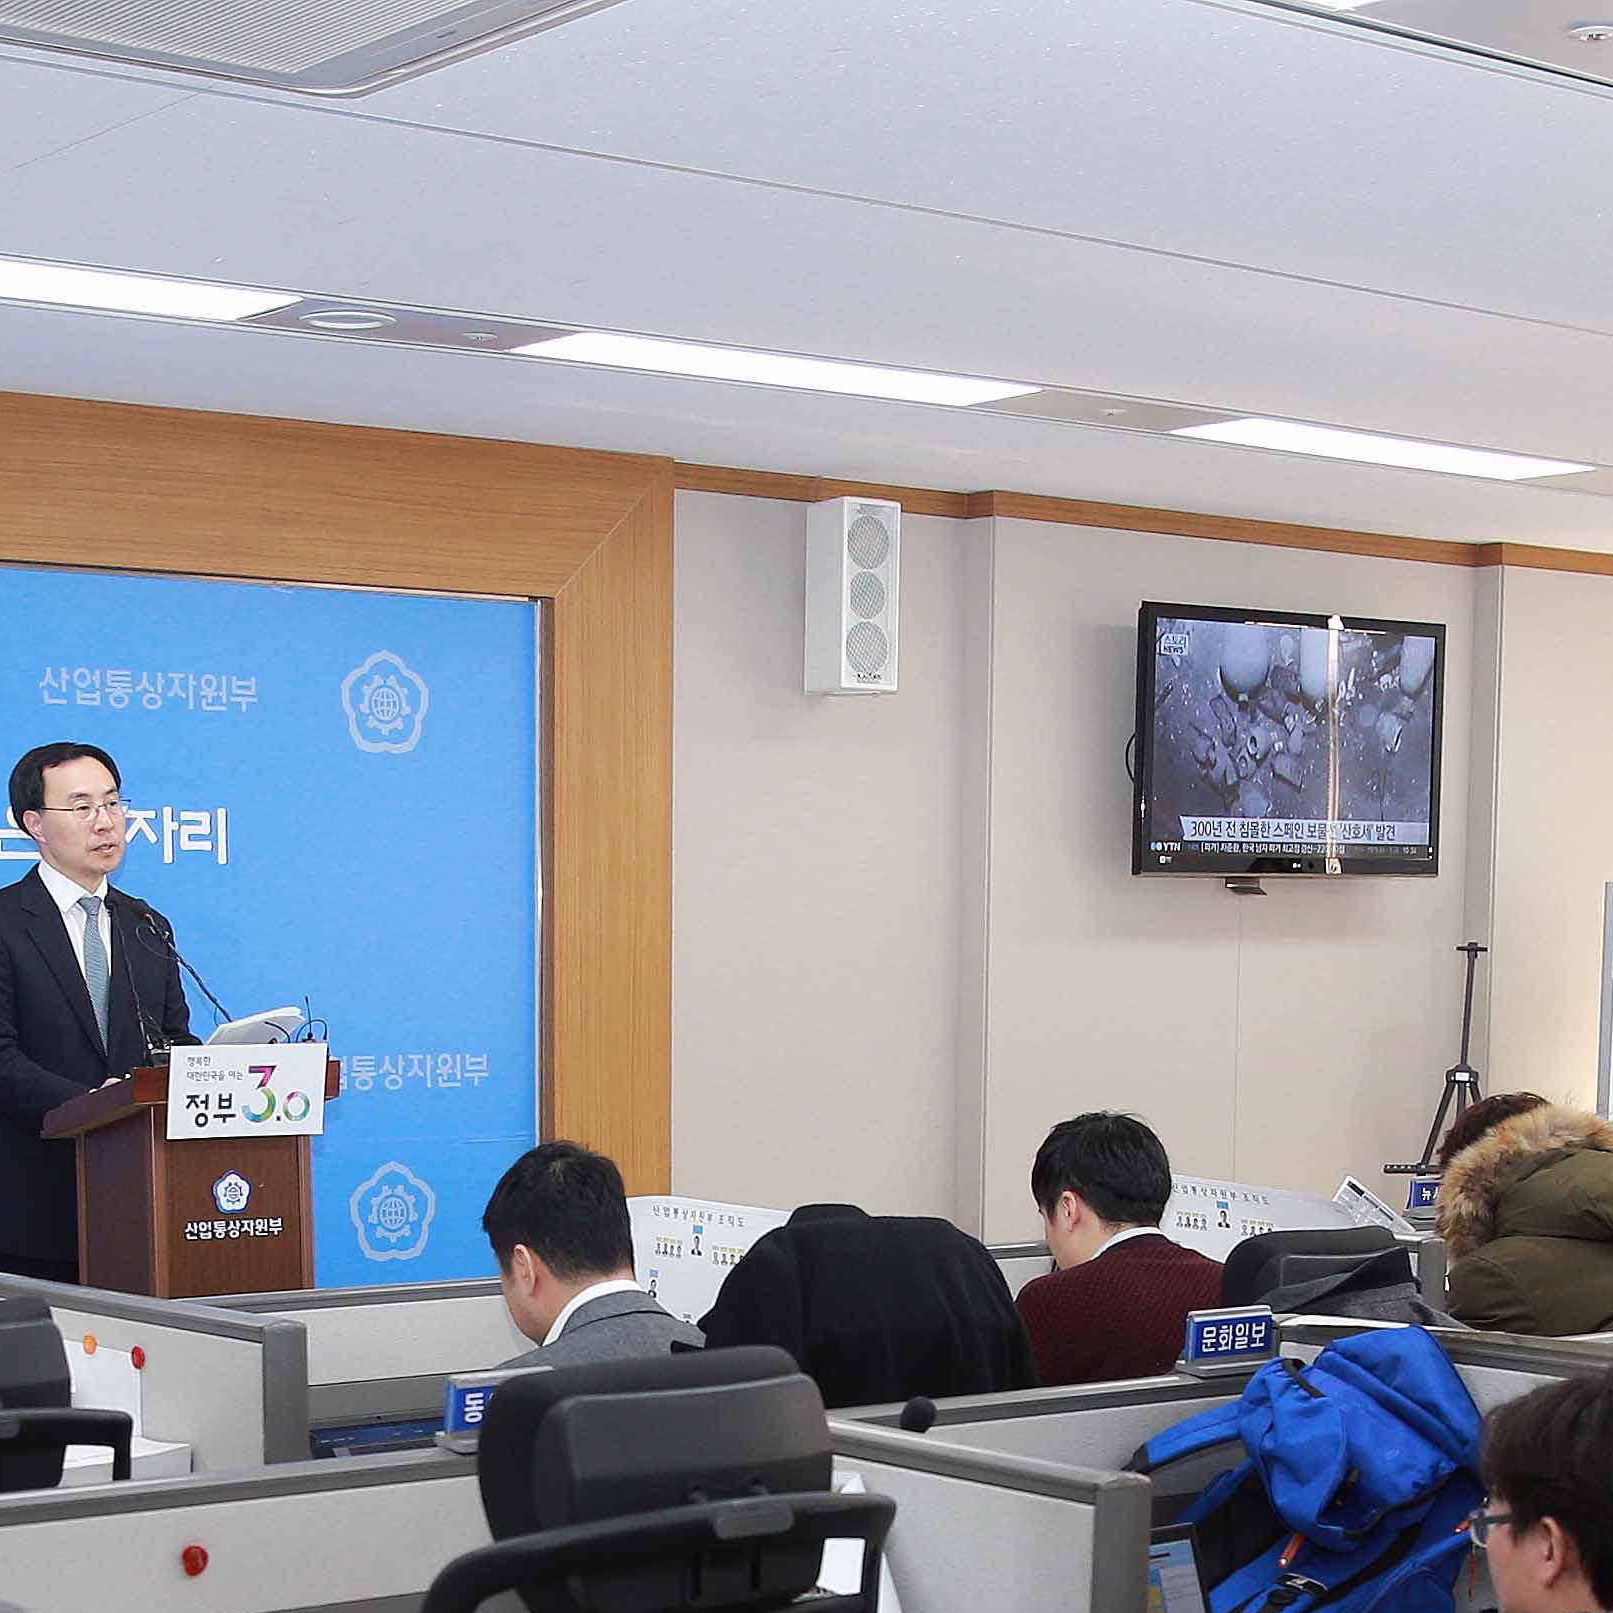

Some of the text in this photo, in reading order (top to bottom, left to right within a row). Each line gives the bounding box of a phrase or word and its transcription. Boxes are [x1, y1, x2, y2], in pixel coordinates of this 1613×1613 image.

[39, 665, 258, 712] 산업통상자원부
[125, 806, 228, 865] 자리
[1163, 842, 1181, 852] YTN
[1190, 821, 1222, 837] 300년
[1225, 821, 1236, 838] 전
[1239, 822, 1271, 839] 침몰한
[1376, 824, 1396, 841] 발견
[186, 1070, 225, 1082] 대한민국을
[340, 1053, 489, 1091] 통상자원부
[186, 1065, 311, 1128] 정부 3.0
[184, 1217, 283, 1241] 산업통상자원부
[1202, 1321, 1266, 1353] 문화일보
